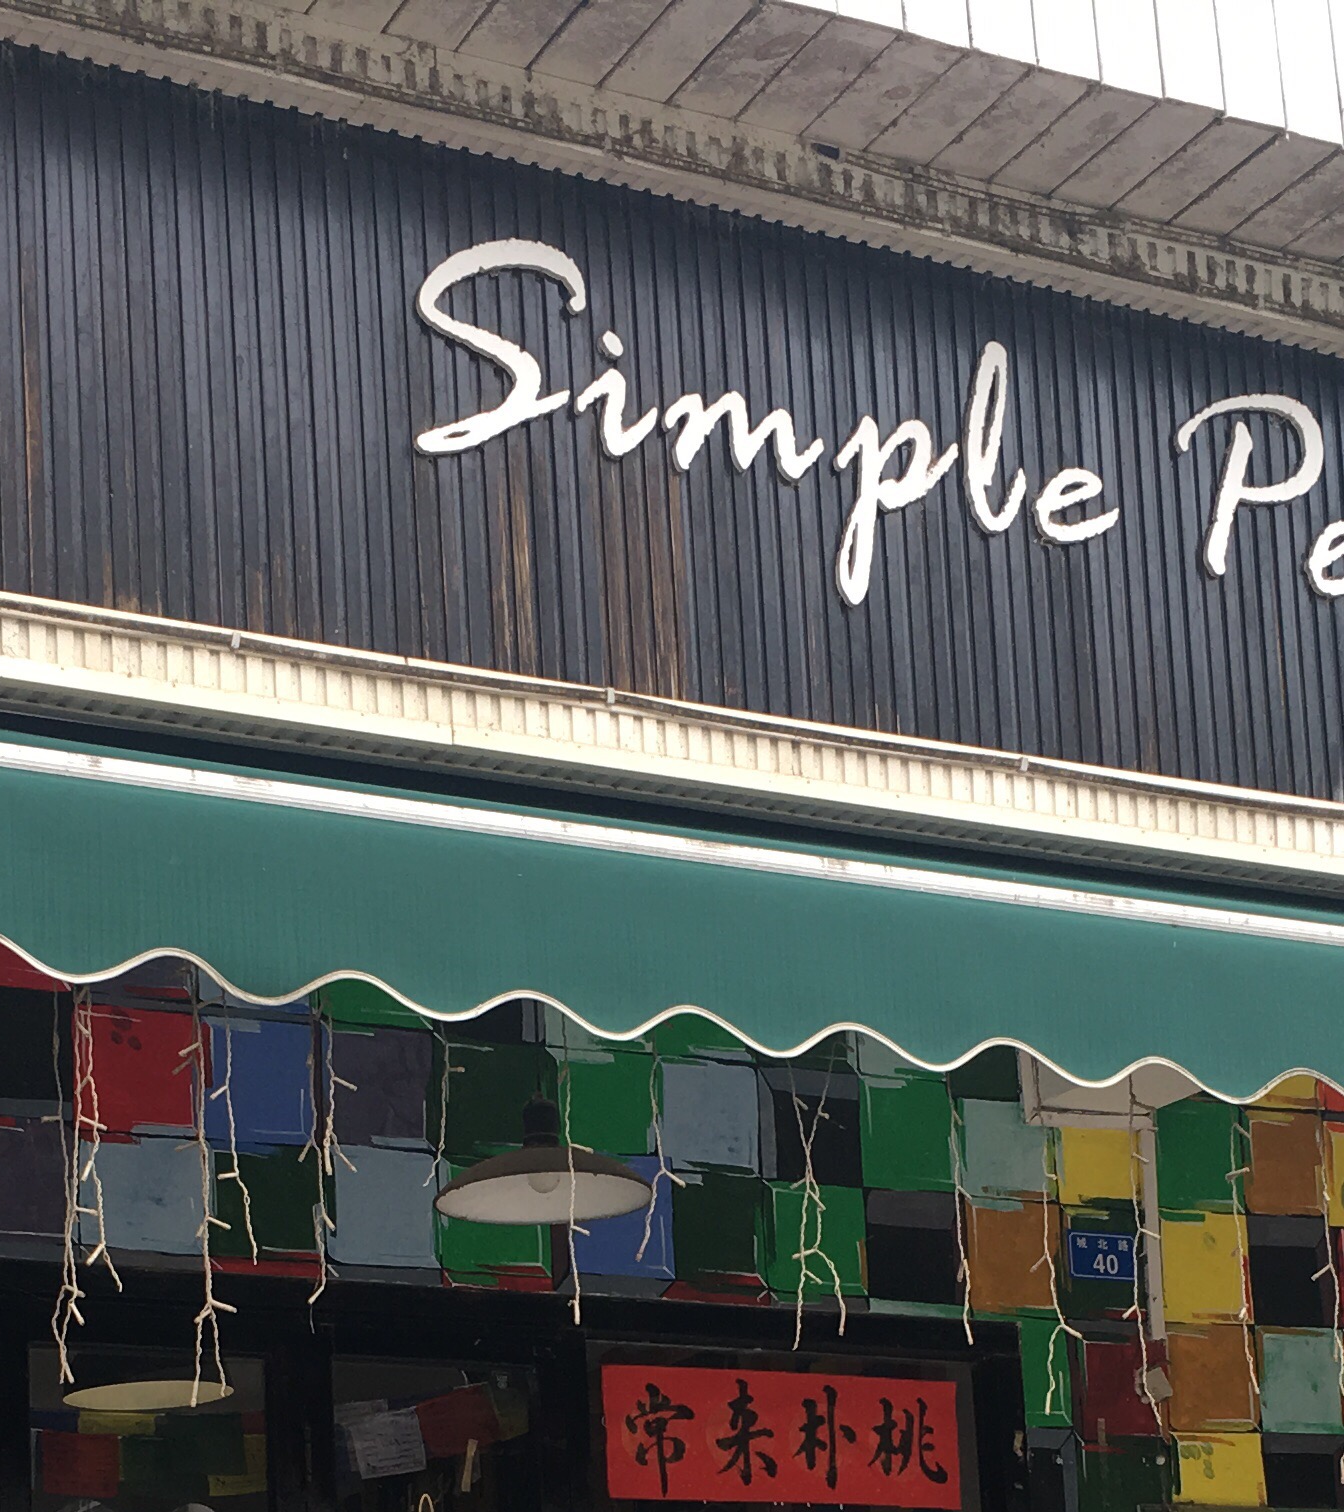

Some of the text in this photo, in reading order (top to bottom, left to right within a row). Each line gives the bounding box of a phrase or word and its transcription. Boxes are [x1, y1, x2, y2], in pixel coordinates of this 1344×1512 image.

[416, 238, 1120, 606] Simple
[1093, 1253, 1119, 1275] 40
[624, 1377, 949, 1499] 常来朴桃
